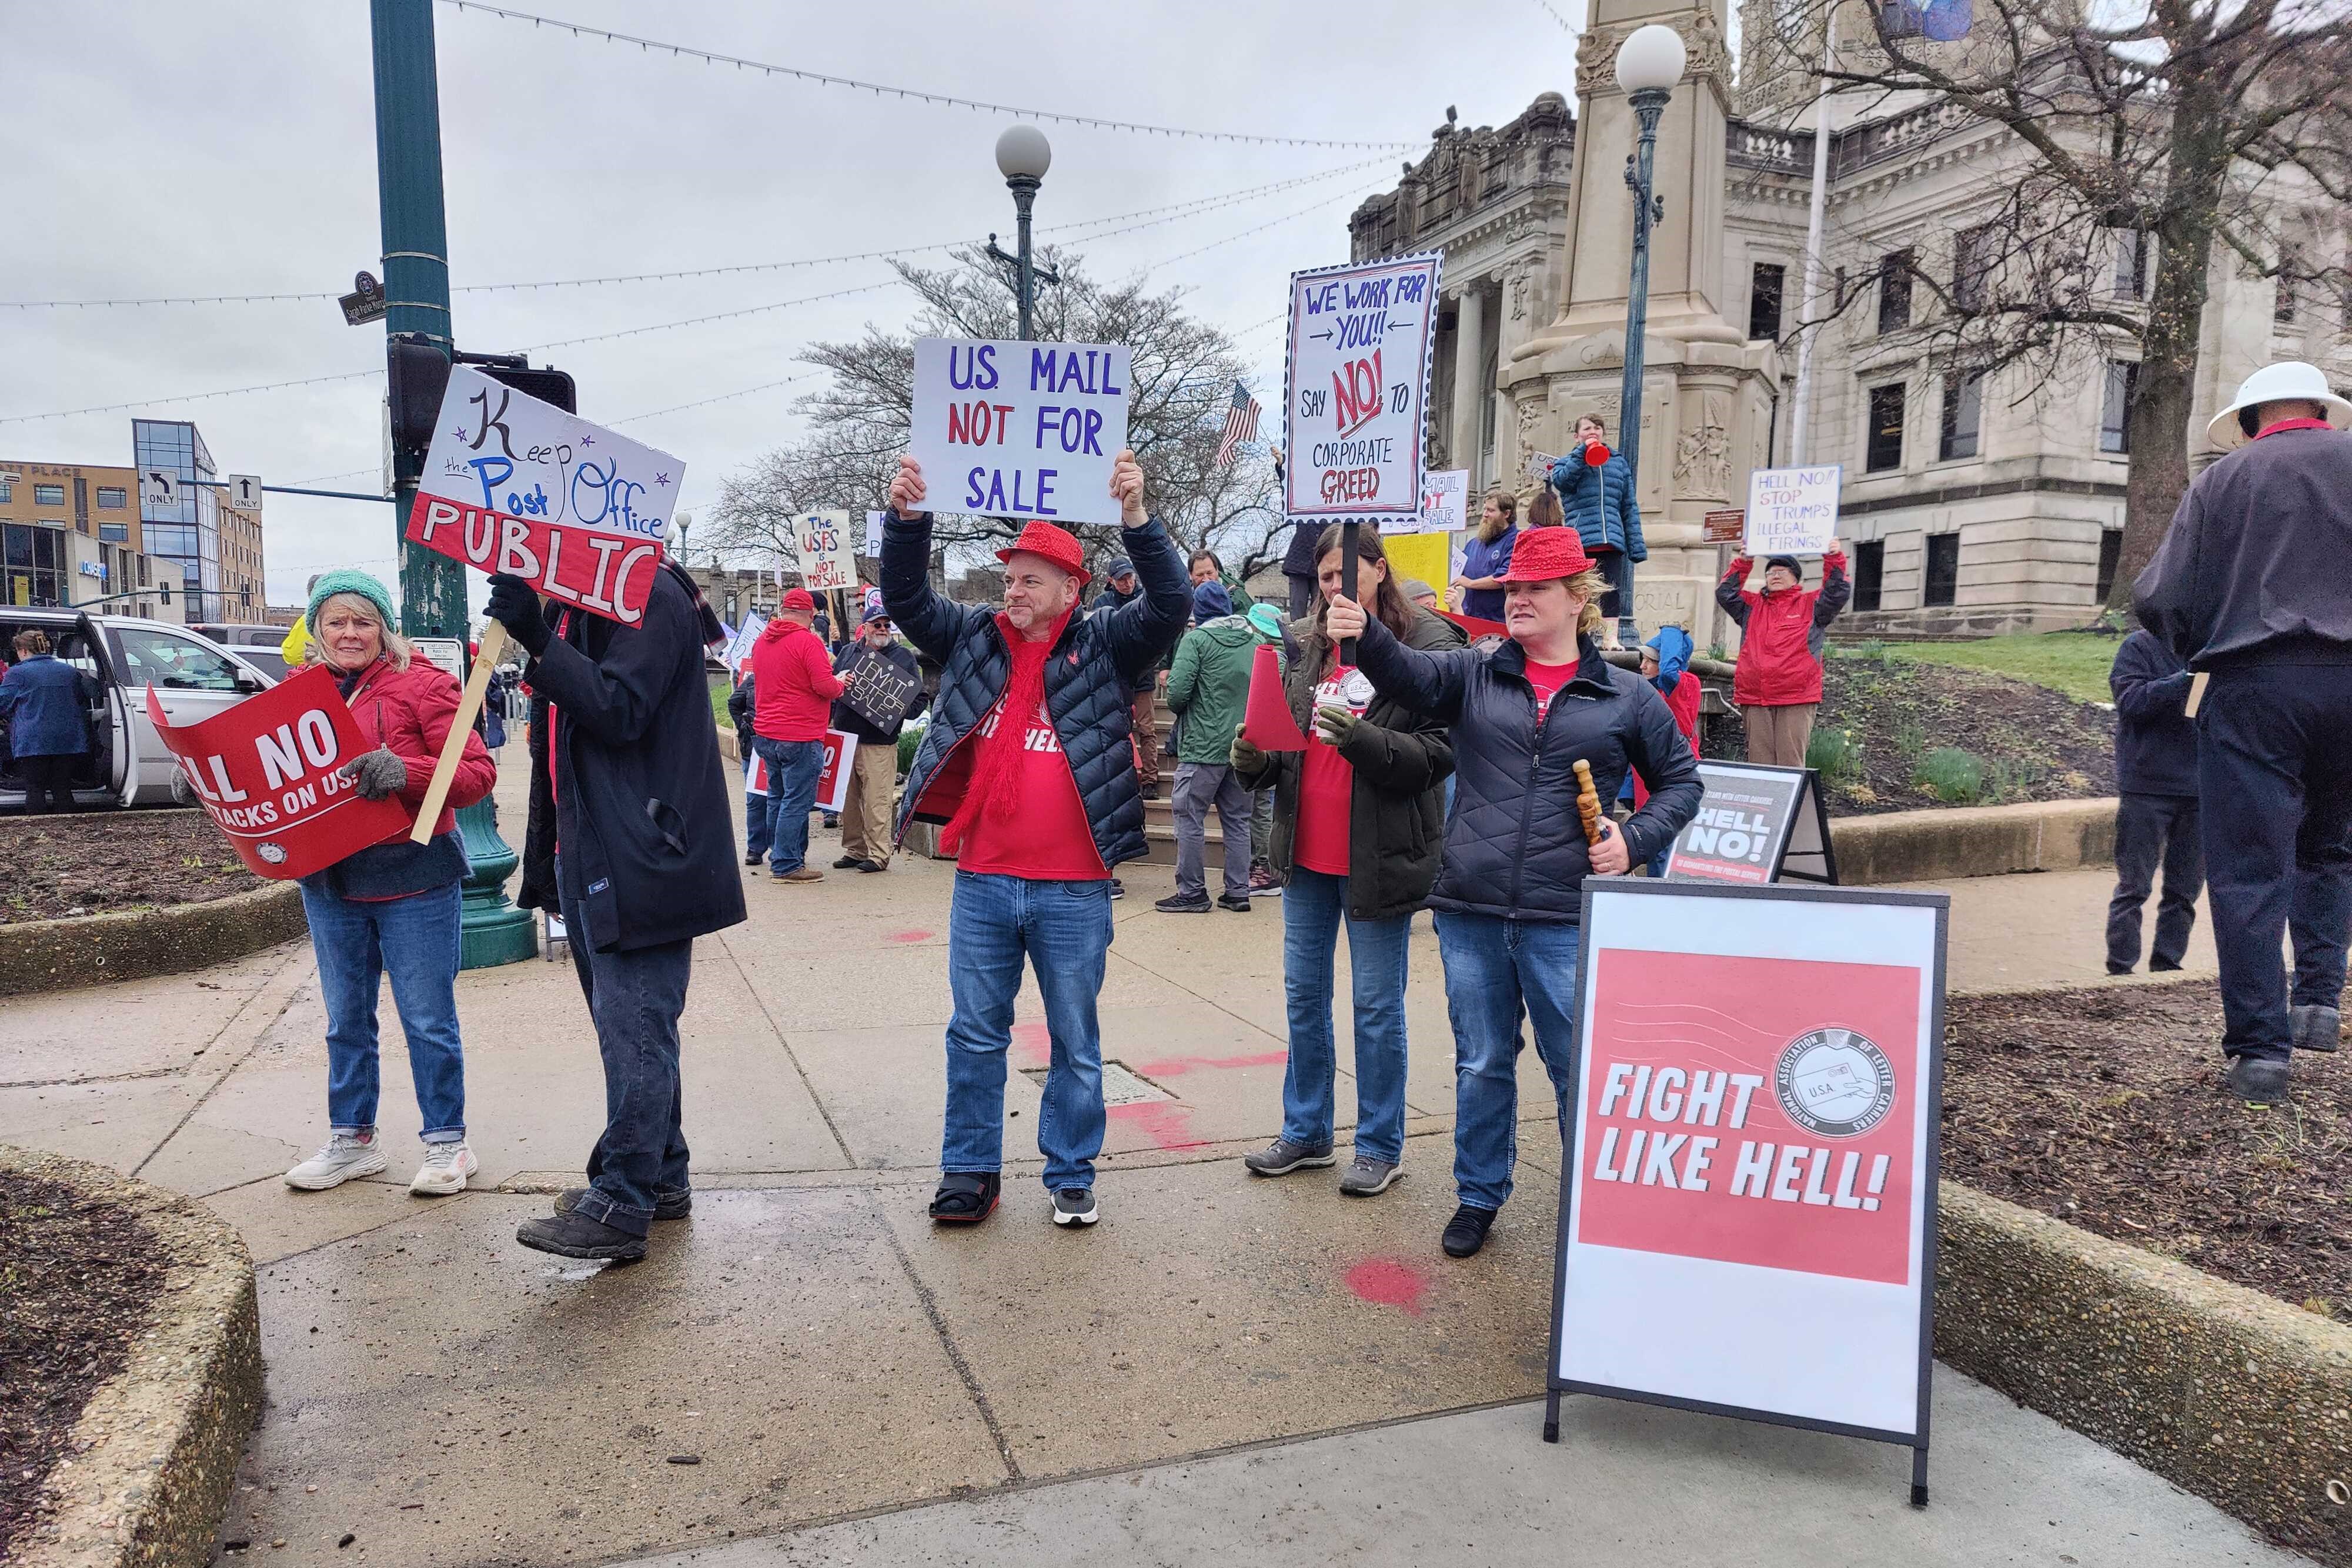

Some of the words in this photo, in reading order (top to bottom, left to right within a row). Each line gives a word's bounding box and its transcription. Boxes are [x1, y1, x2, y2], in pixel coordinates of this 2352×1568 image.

[1305, 282, 1339, 315] WE
[1344, 278, 1392, 309] WORK
[1394, 274, 1426, 304] FOR
[1336, 310, 1387, 350] YOU!!
[950, 345, 998, 390] U.S.
[1030, 348, 1121, 395] MAIL
[1301, 389, 1326, 417] SAY
[1332, 347, 1382, 432] NO!
[1391, 382, 1409, 414] TO
[948, 400, 1015, 446] NOT
[1036, 406, 1103, 456] FOR
[468, 387, 572, 522] Keep
[1313, 438, 1393, 467] CORPORATE
[31, 465, 81, 477] PLACE
[1320, 467, 1380, 504] GREED
[1759, 475, 1790, 489] HELL
[149, 494, 174, 504] ONLY
[445, 456, 468, 473] the
[468, 457, 548, 516] Post
[572, 456, 663, 538] Office
[965, 467, 1058, 515] SALE
[1760, 490, 1802, 505] STOP
[808, 517, 833, 530] The
[1757, 522, 1810, 536] ILLEGAL
[803, 529, 839, 552] USPS
[1769, 536, 1822, 550] FIRINGS
[83, 561, 101, 577] CHASE
[423, 500, 655, 623] PUBLIC
[815, 560, 835, 574] NOT
[807, 574, 822, 588] FOR
[823, 571, 846, 587] SALE
[255, 709, 338, 790] NO
[1024, 728, 1062, 753] HEL
[823, 745, 836, 767] O
[282, 783, 317, 815] ON
[1733, 794, 1750, 803] LETTER
[1750, 795, 1774, 805] CARRIERS
[1694, 807, 1770, 834] HELL
[1686, 826, 1767, 862] NO!
[1714, 865, 1723, 874] THE
[1723, 867, 1740, 877] POSTAL
[1741, 870, 1762, 881] SERVICE
[1779, 1035, 1819, 1086] ASSOCIATION
[1859, 1040, 1872, 1053] OF
[1872, 1054, 1892, 1087] LETTER
[1598, 1062, 1766, 1129] FIGHT
[1809, 1084, 1836, 1098] U.S.A.
[1782, 1091, 1817, 1128] NATIONAL
[1852, 1093, 1891, 1131] CARRIERS
[1594, 1126, 1720, 1192] LIKE
[1730, 1141, 1892, 1212] HELL!
